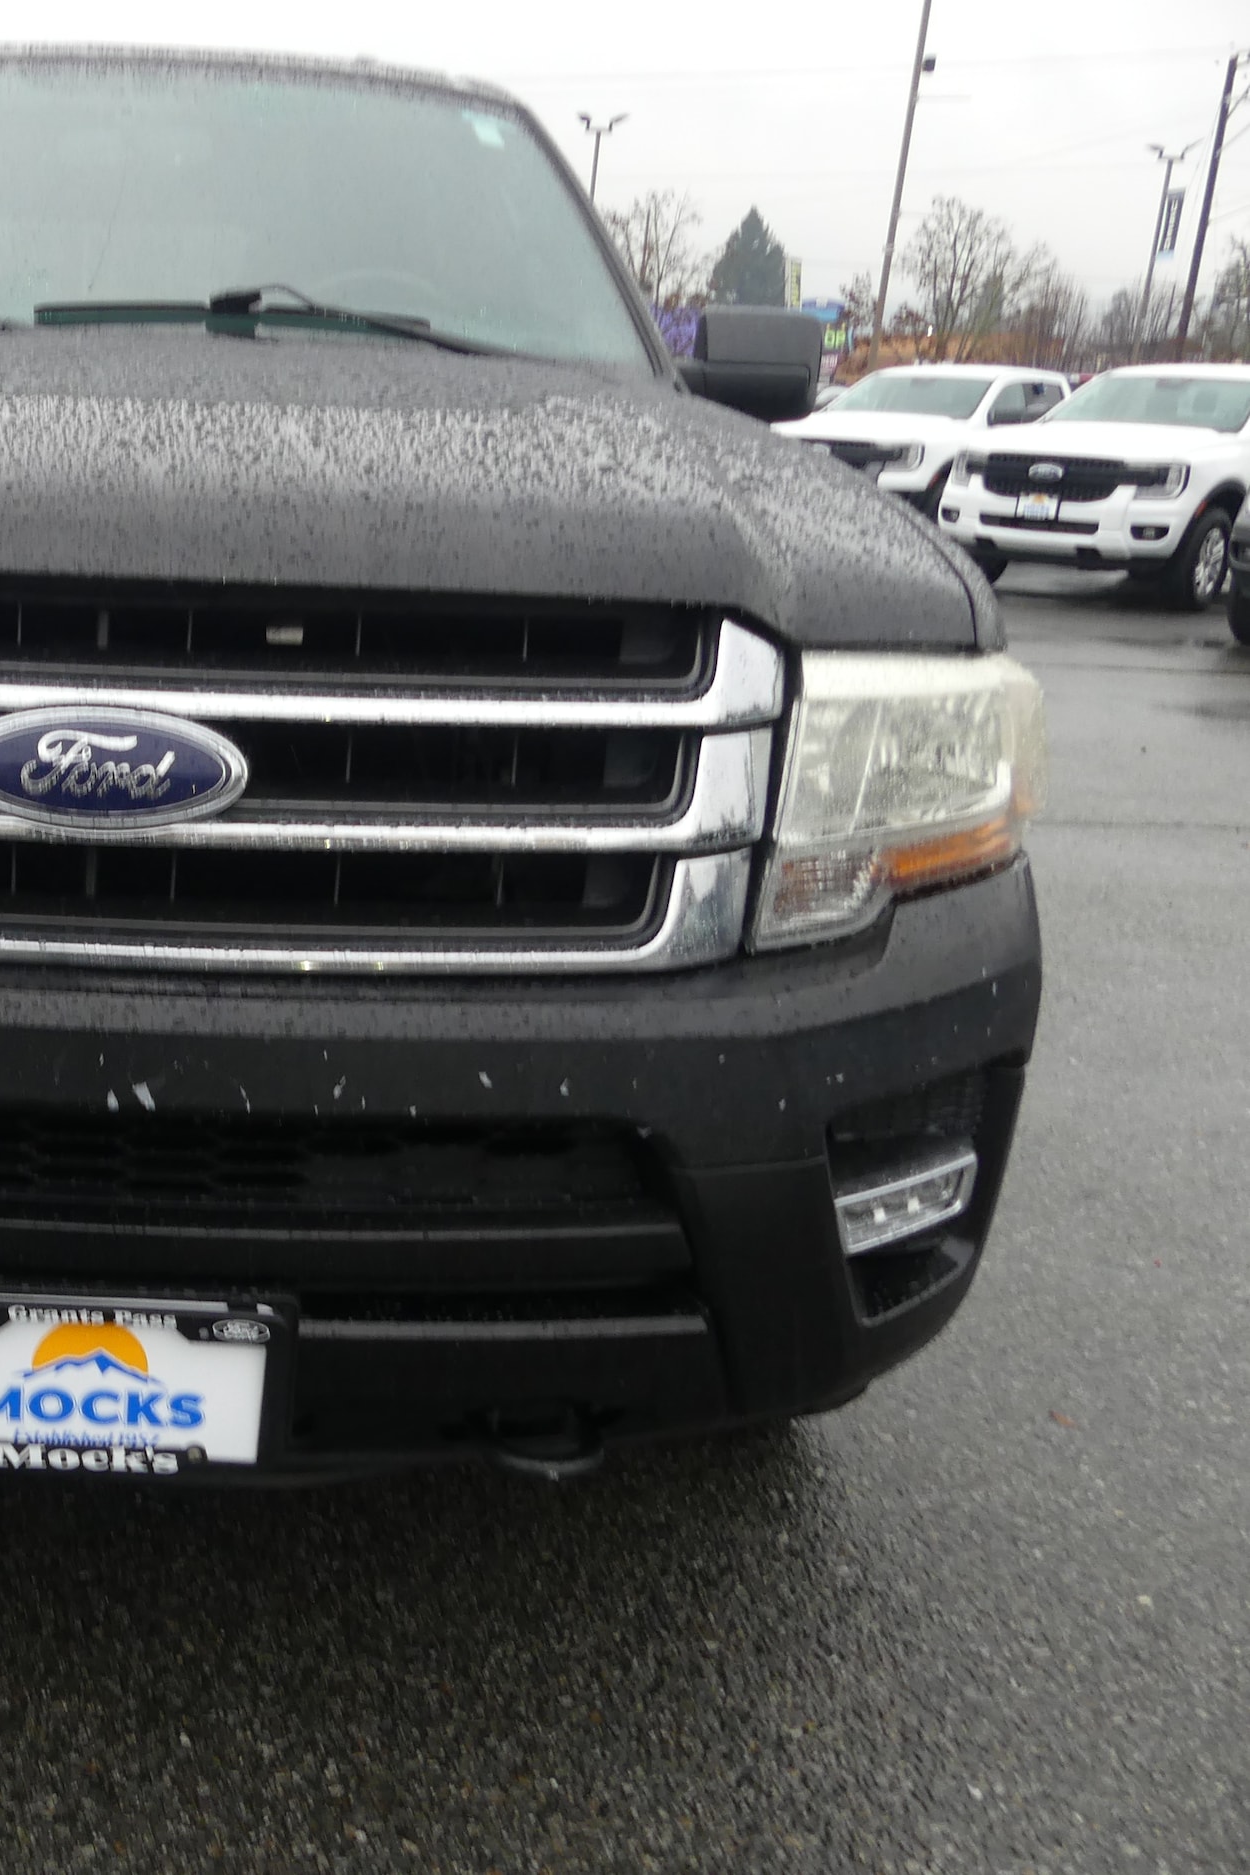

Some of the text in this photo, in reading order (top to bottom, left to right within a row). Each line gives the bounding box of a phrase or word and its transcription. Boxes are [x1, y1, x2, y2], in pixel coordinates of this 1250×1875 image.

[20, 729, 176, 800] Ford
[8, 1304, 177, 1329] Grants Pass
